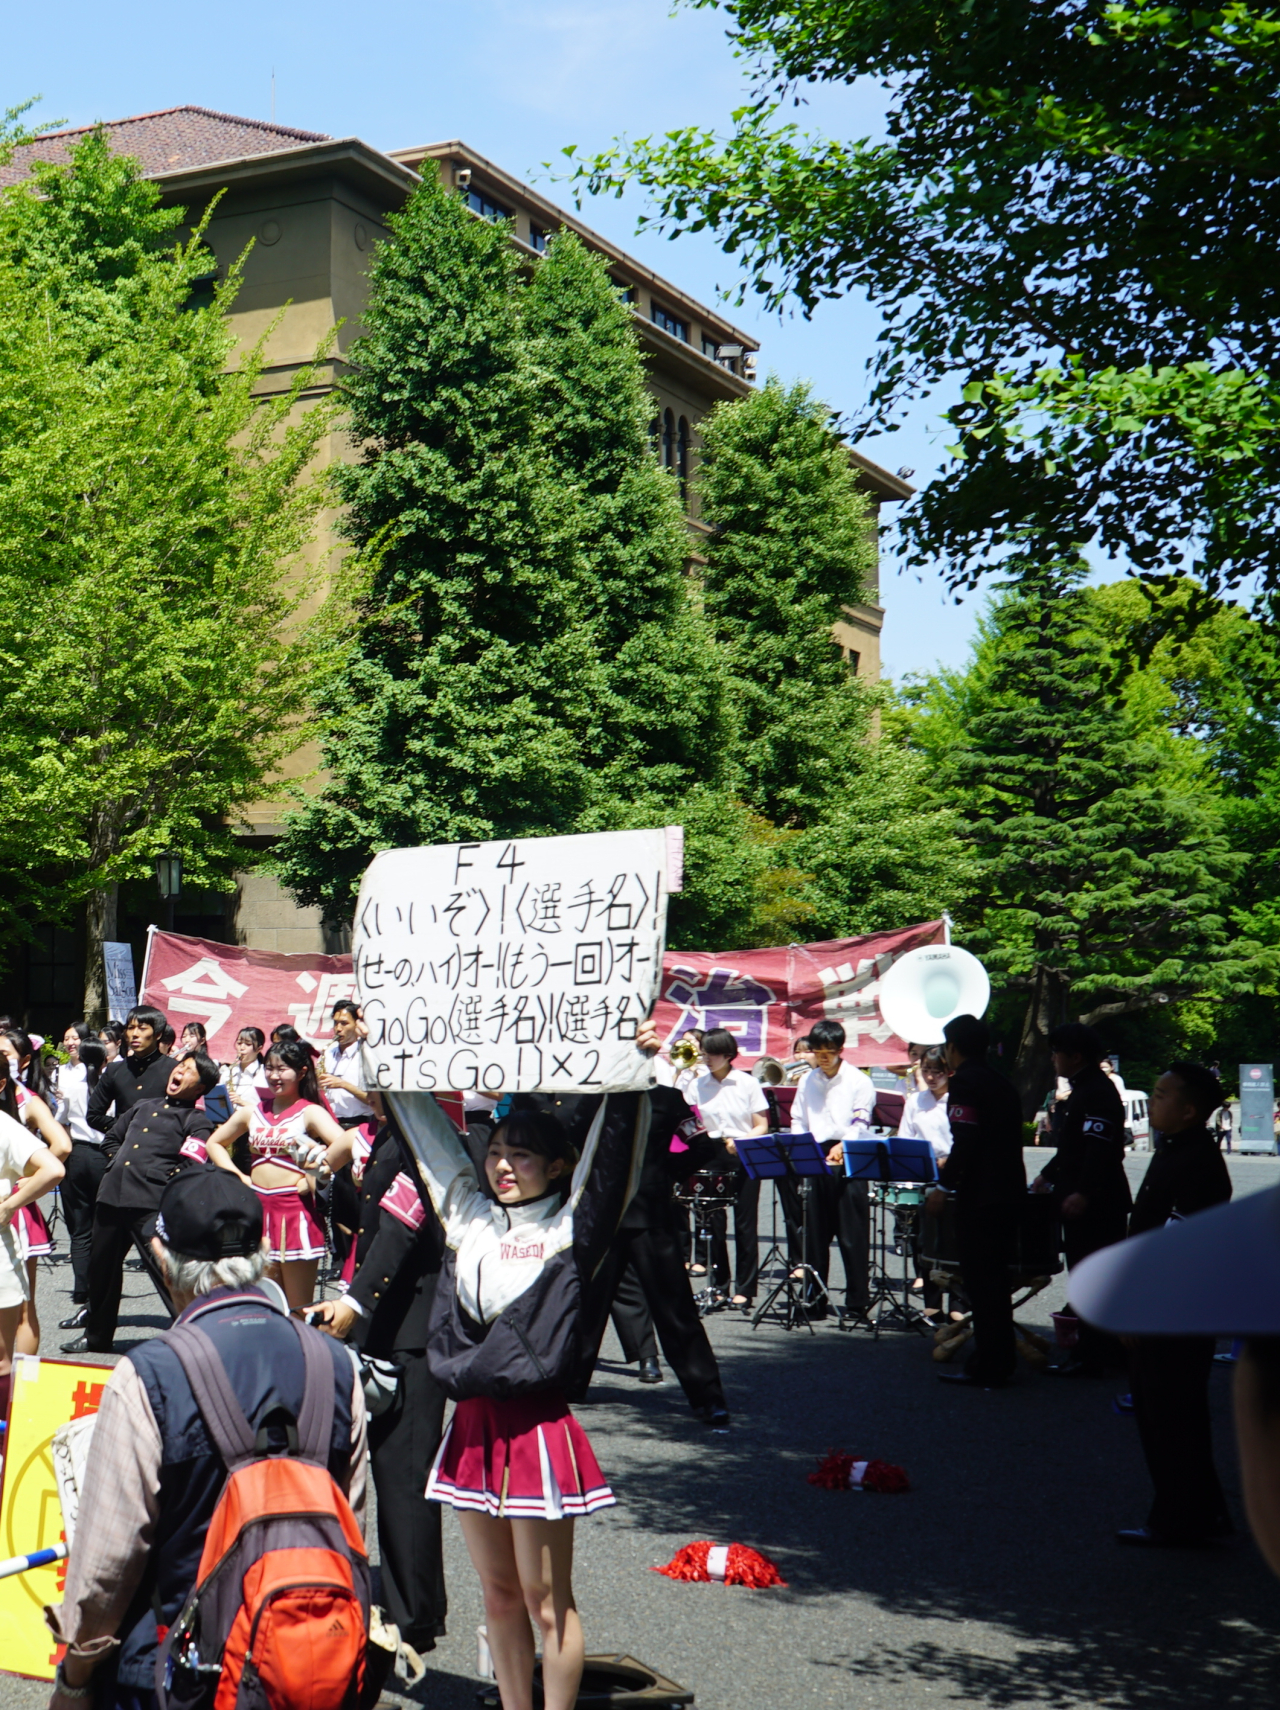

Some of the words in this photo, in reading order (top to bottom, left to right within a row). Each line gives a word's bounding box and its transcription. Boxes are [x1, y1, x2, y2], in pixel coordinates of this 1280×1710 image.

[107, 961, 127, 979] Miss
[108, 979, 136, 998] Saigon
[370, 1045, 437, 1090] et's
[251, 1135, 286, 1147] Waseda
